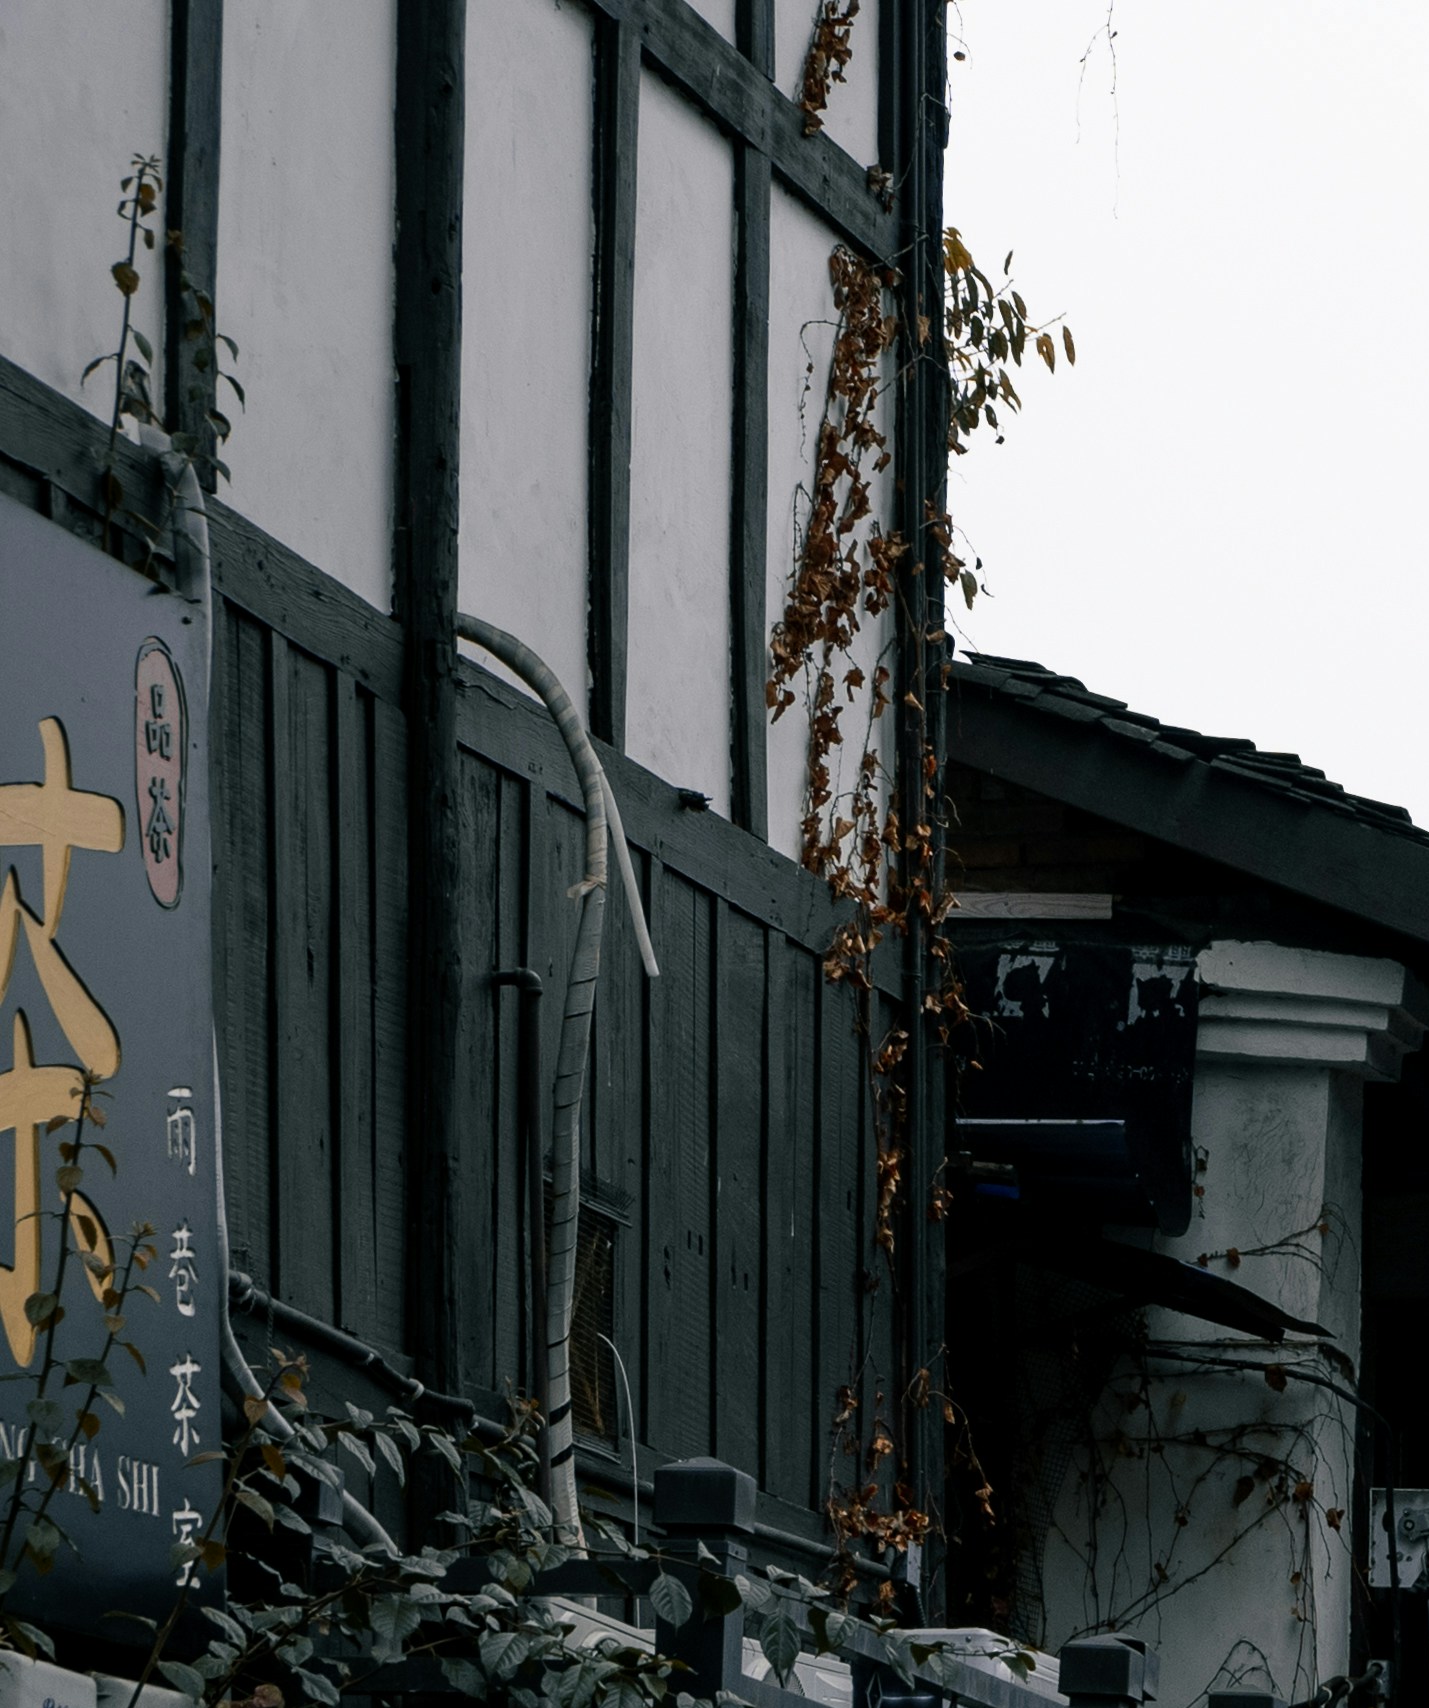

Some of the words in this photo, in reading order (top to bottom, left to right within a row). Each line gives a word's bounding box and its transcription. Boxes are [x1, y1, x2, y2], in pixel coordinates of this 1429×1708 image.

[146, 683, 176, 864] 品茶
[166, 1086, 202, 1590] 雨巷茶室
[117, 1455, 160, 1517] SHI
